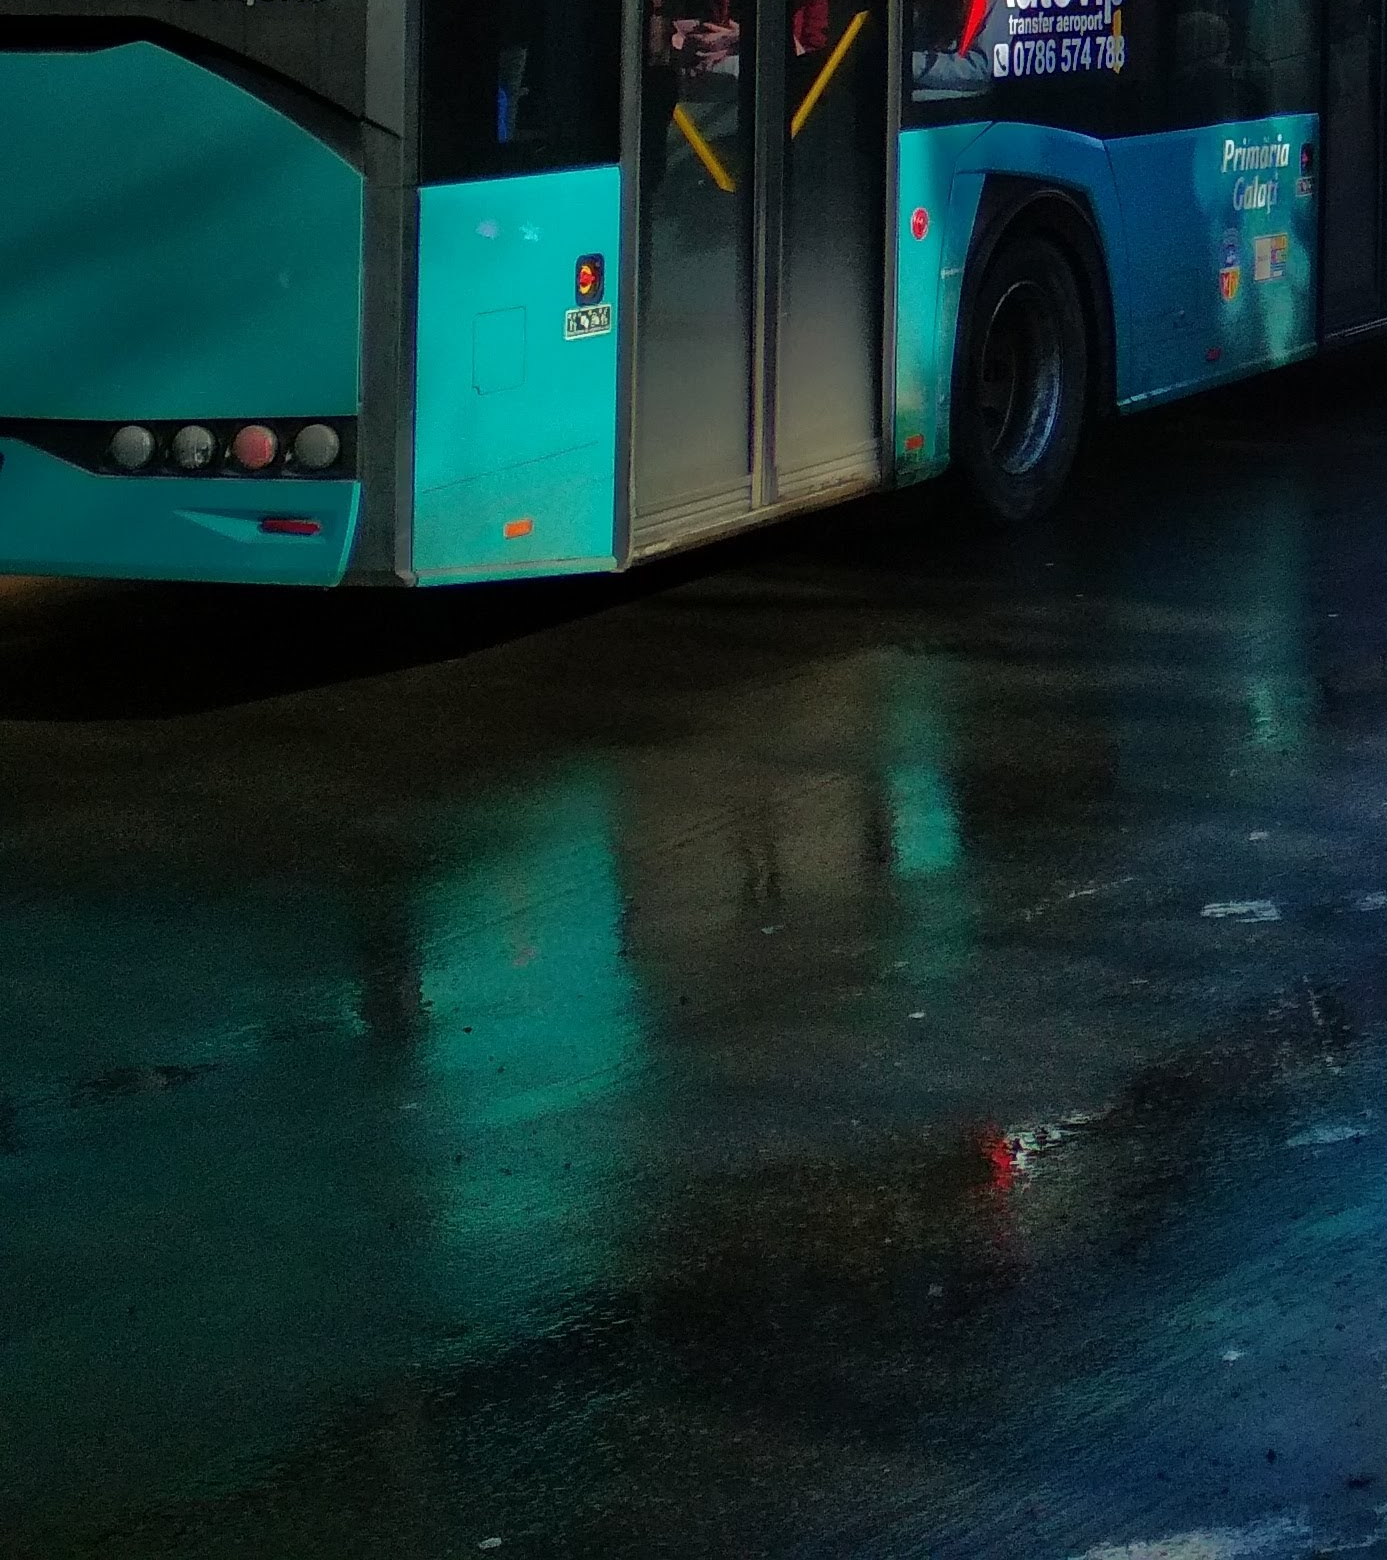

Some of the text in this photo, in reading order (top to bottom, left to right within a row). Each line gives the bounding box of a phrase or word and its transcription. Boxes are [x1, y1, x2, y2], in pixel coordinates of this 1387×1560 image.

[1008, 11, 1103, 36] transfer aeroport
[1014, 40, 1056, 76] 0786
[1061, 38, 1092, 72] 574
